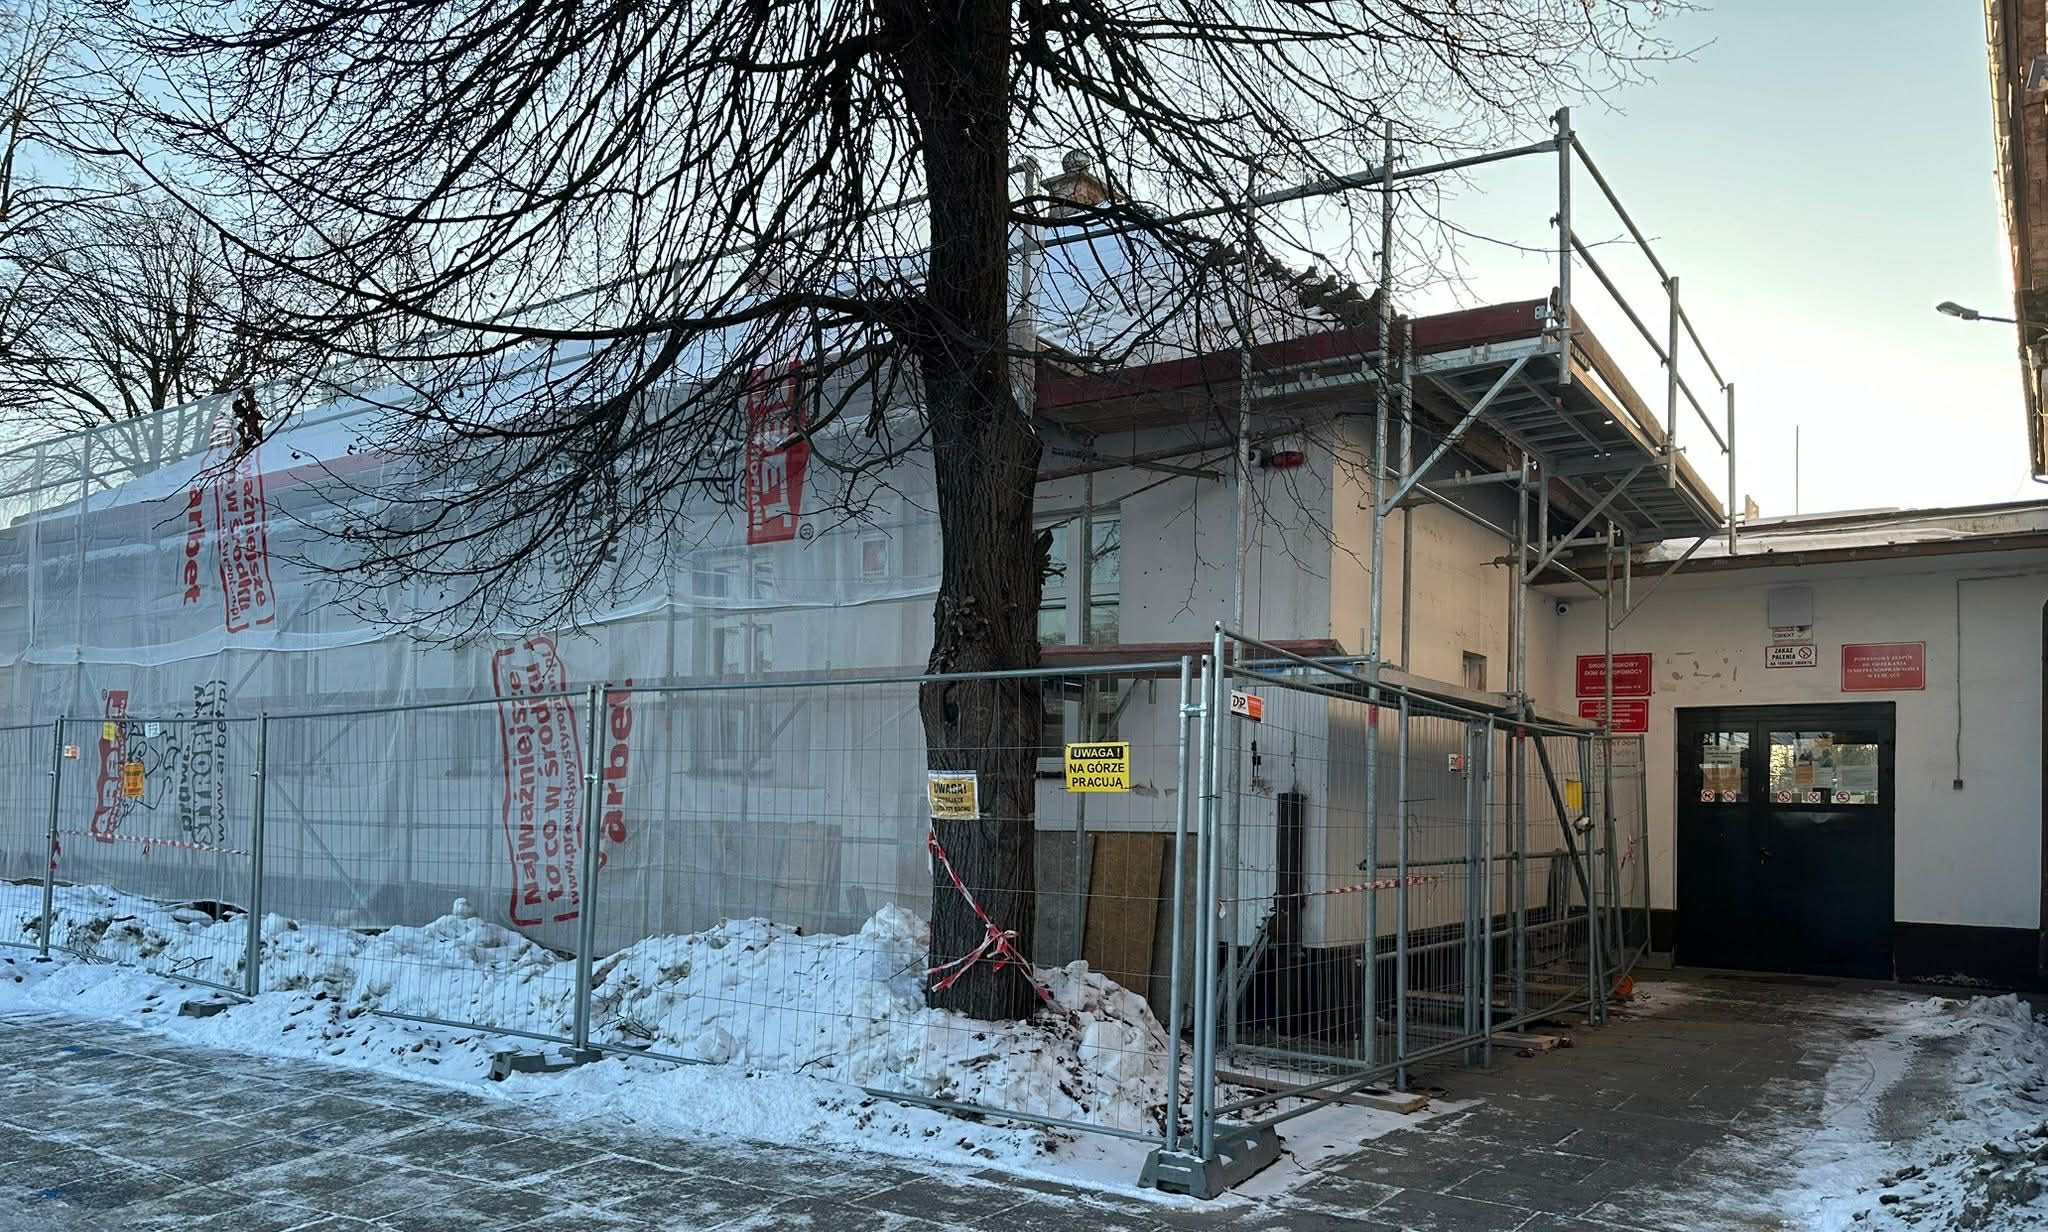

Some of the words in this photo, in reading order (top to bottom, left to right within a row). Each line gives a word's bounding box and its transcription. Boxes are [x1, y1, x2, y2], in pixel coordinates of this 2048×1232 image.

[183, 484, 205, 606] arbet
[526, 663, 561, 785] środku
[213, 681, 228, 843] www.arbet.pl
[1070, 763, 1084, 773] NA
[1087, 760, 1125, 773] GÓRZE
[1074, 748, 1114, 758] UWAGA
[509, 671, 542, 906] Najważniejsze
[544, 786, 562, 814] w
[933, 783, 967, 794] UWAGA!
[1072, 777, 1123, 789] PRACUJĄ
[543, 820, 561, 865] co
[547, 865, 564, 902] to
